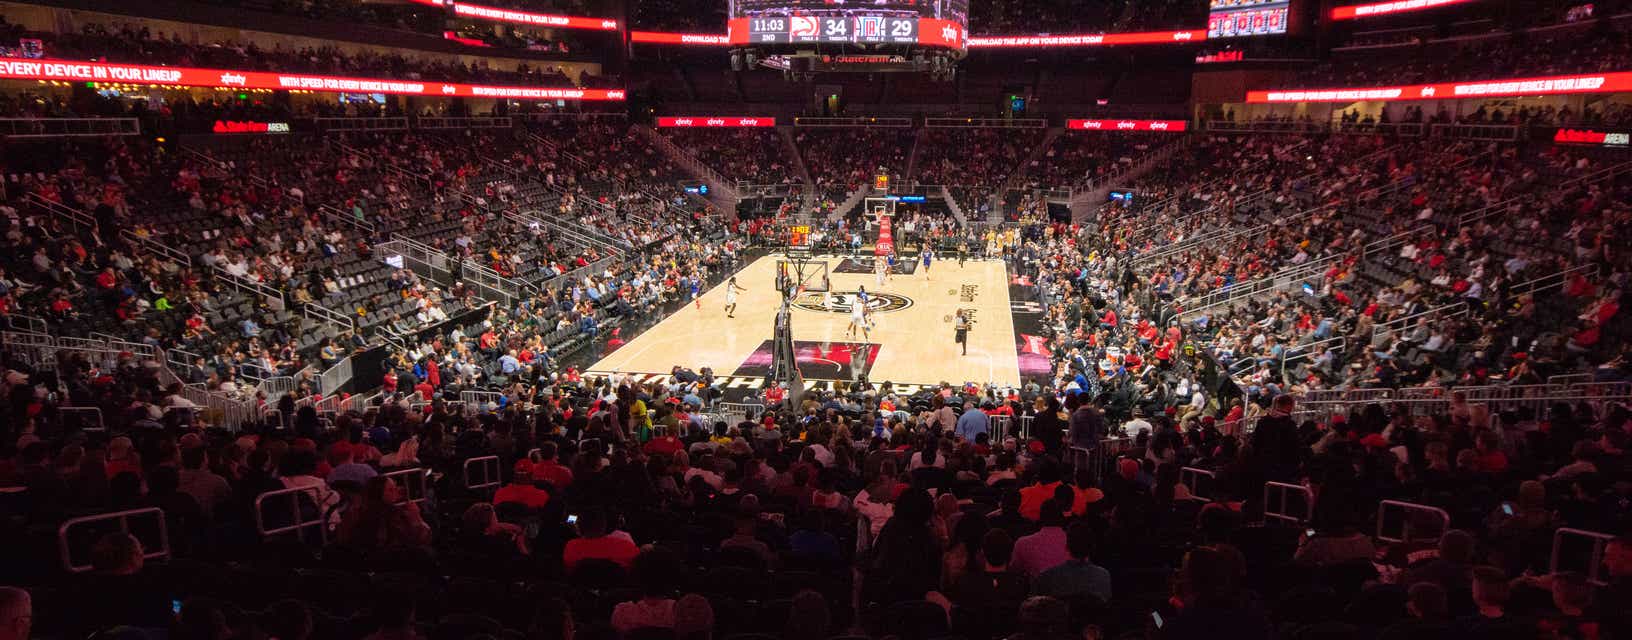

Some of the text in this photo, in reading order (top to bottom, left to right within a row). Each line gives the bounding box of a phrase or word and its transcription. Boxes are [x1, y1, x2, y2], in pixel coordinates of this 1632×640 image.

[487, 9, 504, 19] EVERY
[504, 11, 525, 21] DEVICE
[531, 15, 549, 23] YOUR
[549, 16, 570, 25] LINEUP
[754, 19, 784, 32] 11:03
[825, 19, 847, 36] 34
[891, 20, 912, 36] 29
[682, 34, 719, 43] DOWNLOAD
[762, 34, 776, 42] 2ND
[967, 35, 1104, 46] DOWNLOAD THE APP ON YOUR DEVICE TODAY
[0, 61, 182, 82] EVERY DEVICE IN YOUR LINEUP
[220, 72, 247, 87] xfinity
[279, 76, 425, 93] WITH SPEED FOR EVERY DEVICE IN YOUR LINEUP
[1519, 80, 1546, 92] DEVICE
[1554, 79, 1575, 90] YOUR
[1574, 77, 1604, 90] LINEUP
[507, 88, 522, 97] EVERY
[522, 89, 542, 97] DEVICE
[563, 90, 585, 98] LINEUP
[267, 122, 289, 132] ARENA
[674, 118, 693, 126] xfinity
[706, 118, 725, 126] xfinity
[740, 118, 758, 126] xfinity
[1083, 120, 1102, 128] xfinity
[1117, 121, 1135, 130] xfinity
[1149, 121, 1168, 130] xfinity
